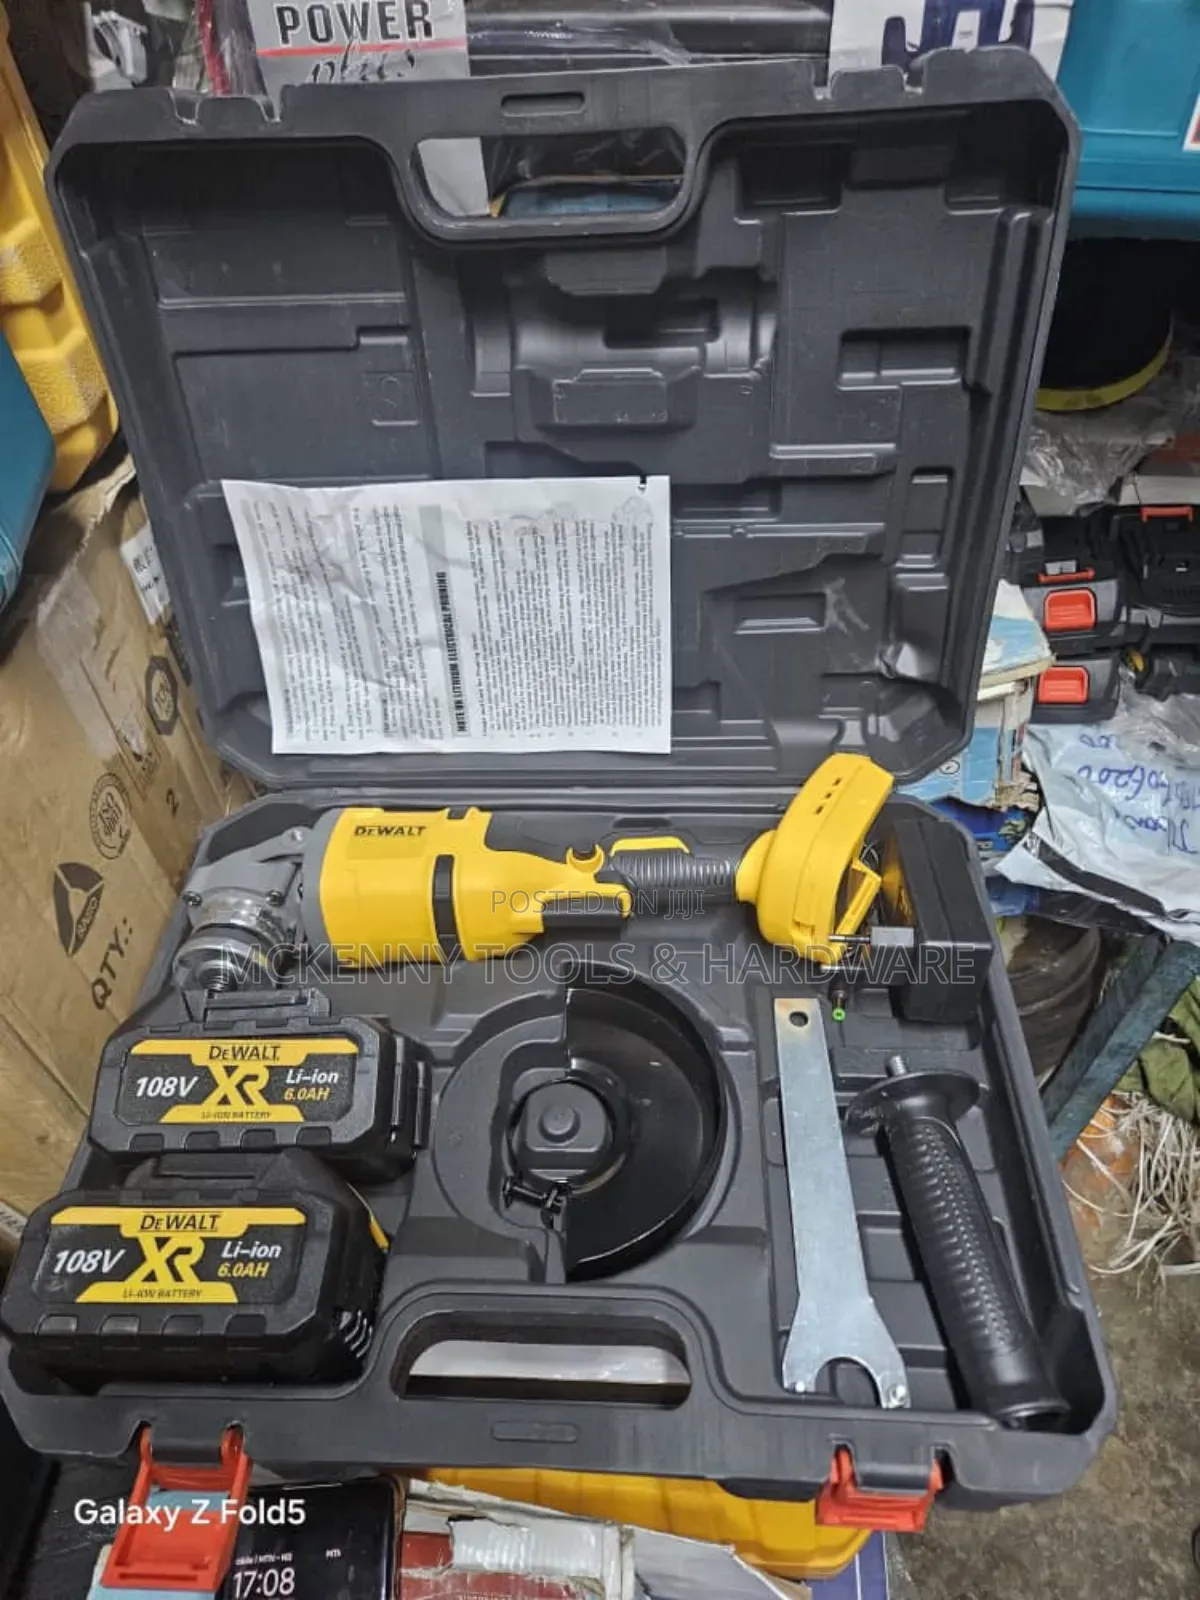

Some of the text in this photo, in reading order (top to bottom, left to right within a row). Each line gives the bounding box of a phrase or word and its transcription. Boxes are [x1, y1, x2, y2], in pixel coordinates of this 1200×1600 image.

[275, 0, 434, 45] POWER
[135, 1064, 269, 1106] 108V XR
[285, 1068, 339, 1085] Li-ion
[283, 1086, 331, 1101] 6.0AH
[53, 1236, 205, 1283] 108V XR
[221, 1240, 283, 1259] Li-ion
[217, 1262, 270, 1278] 6.0AH
[233, 1566, 295, 1600] 17:08
